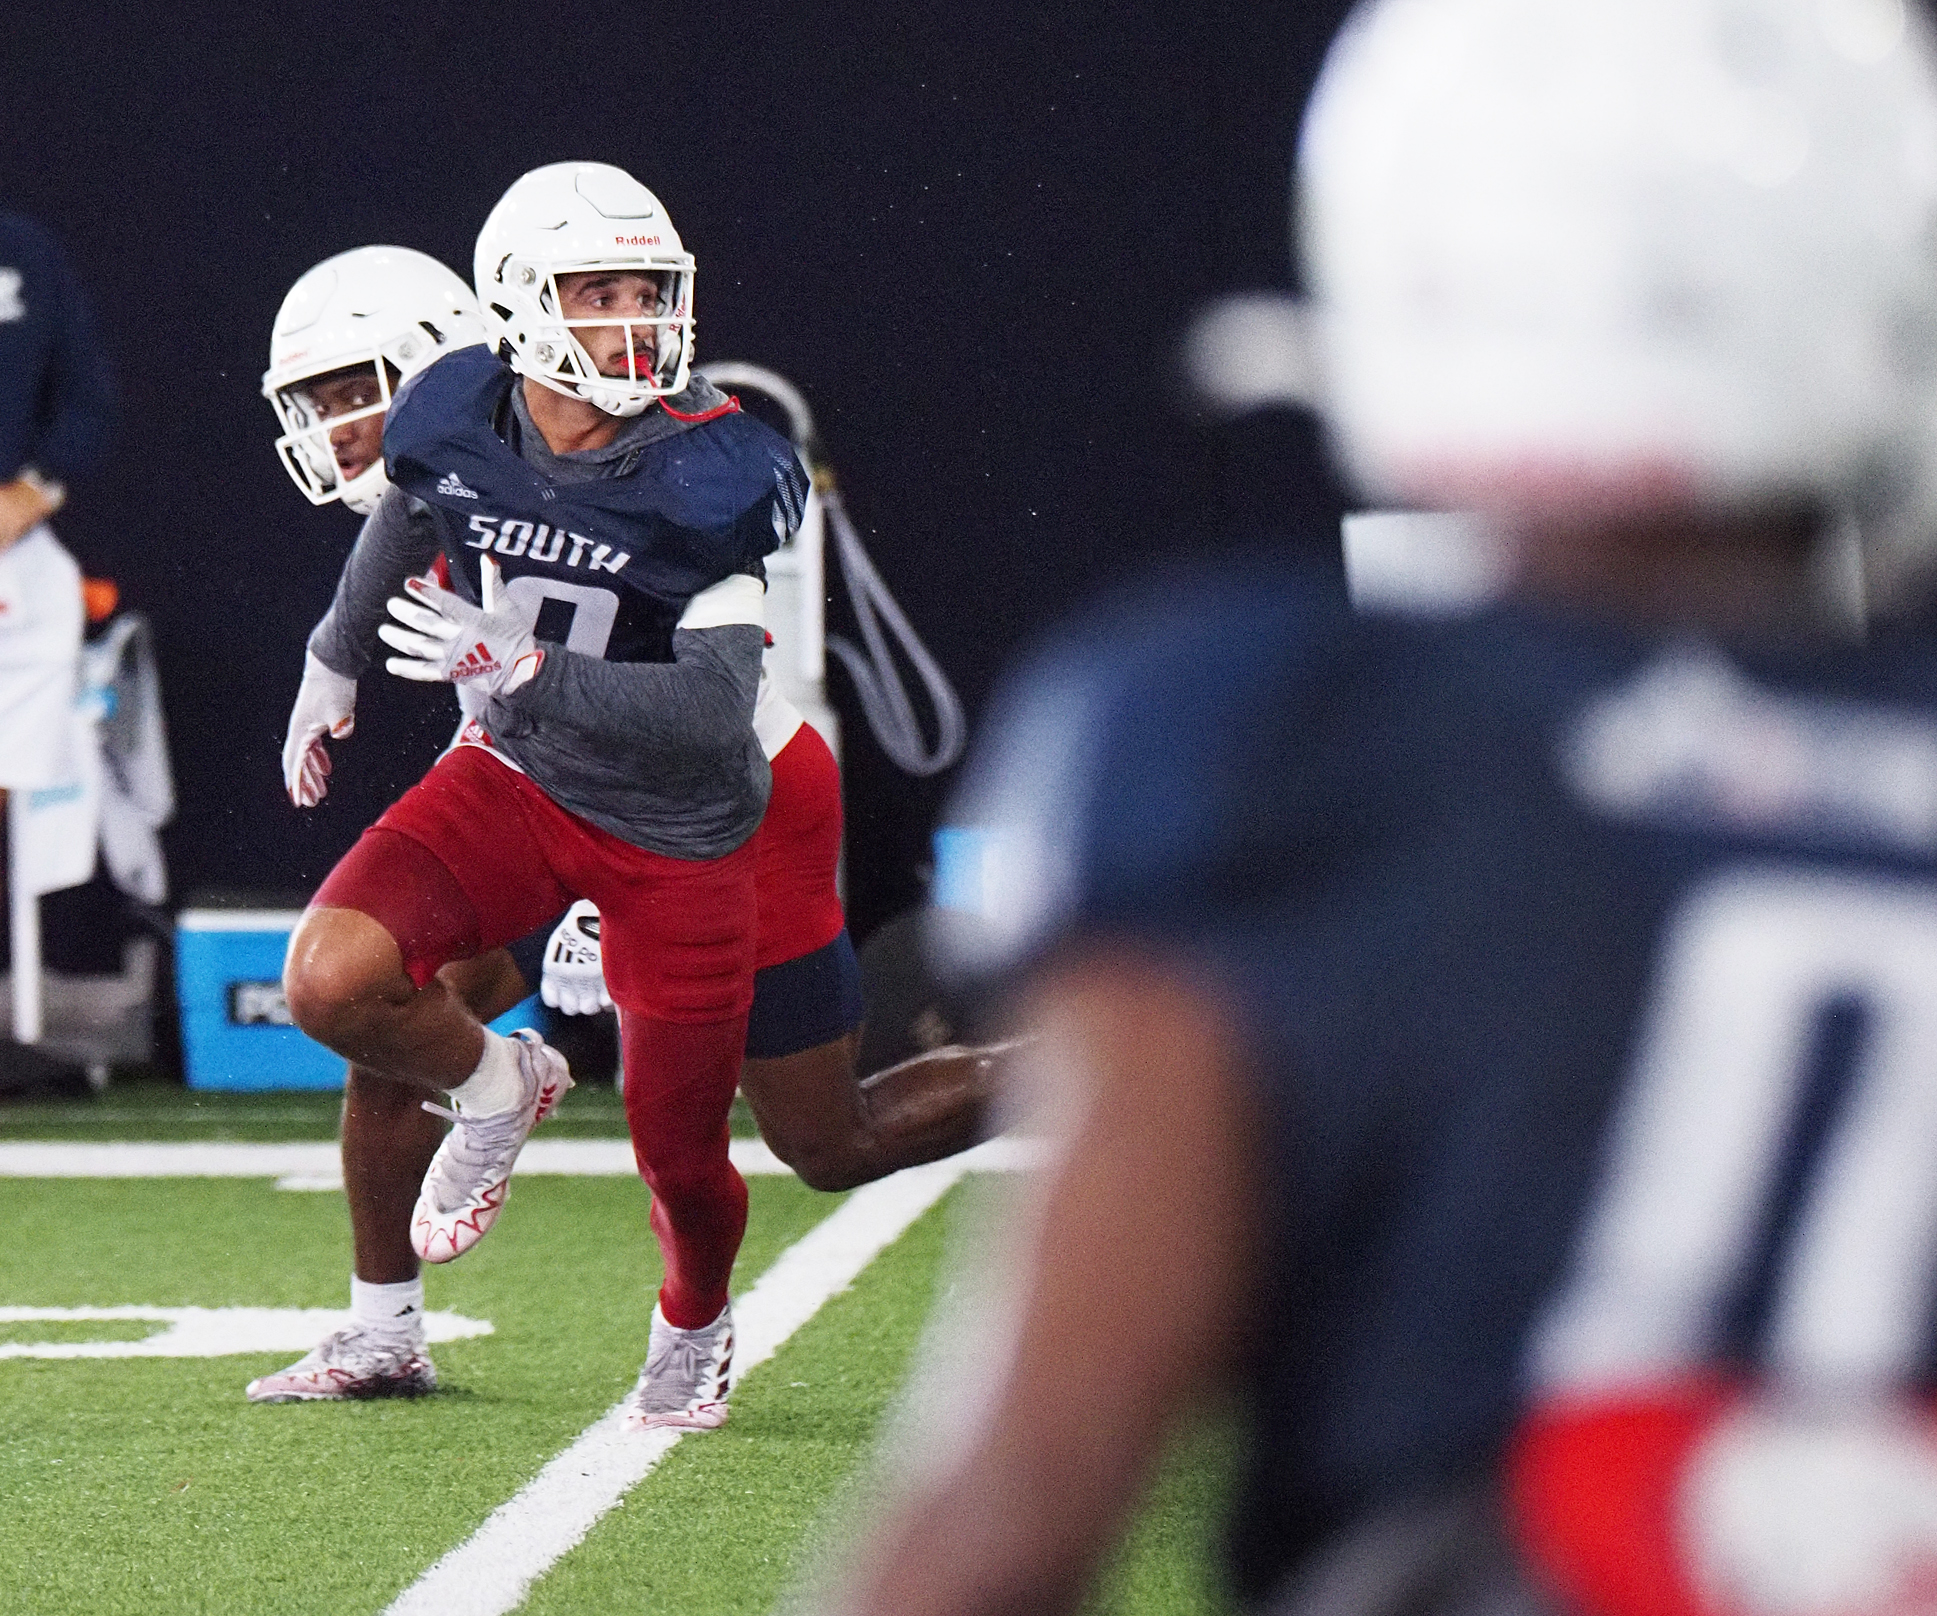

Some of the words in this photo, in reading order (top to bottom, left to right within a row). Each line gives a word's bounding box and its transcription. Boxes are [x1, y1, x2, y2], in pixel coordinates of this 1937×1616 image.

[615, 236, 661, 246] Riddell
[437, 484, 479, 500] adidas
[465, 514, 632, 574] SOUTH
[450, 660, 502, 679] adidas
